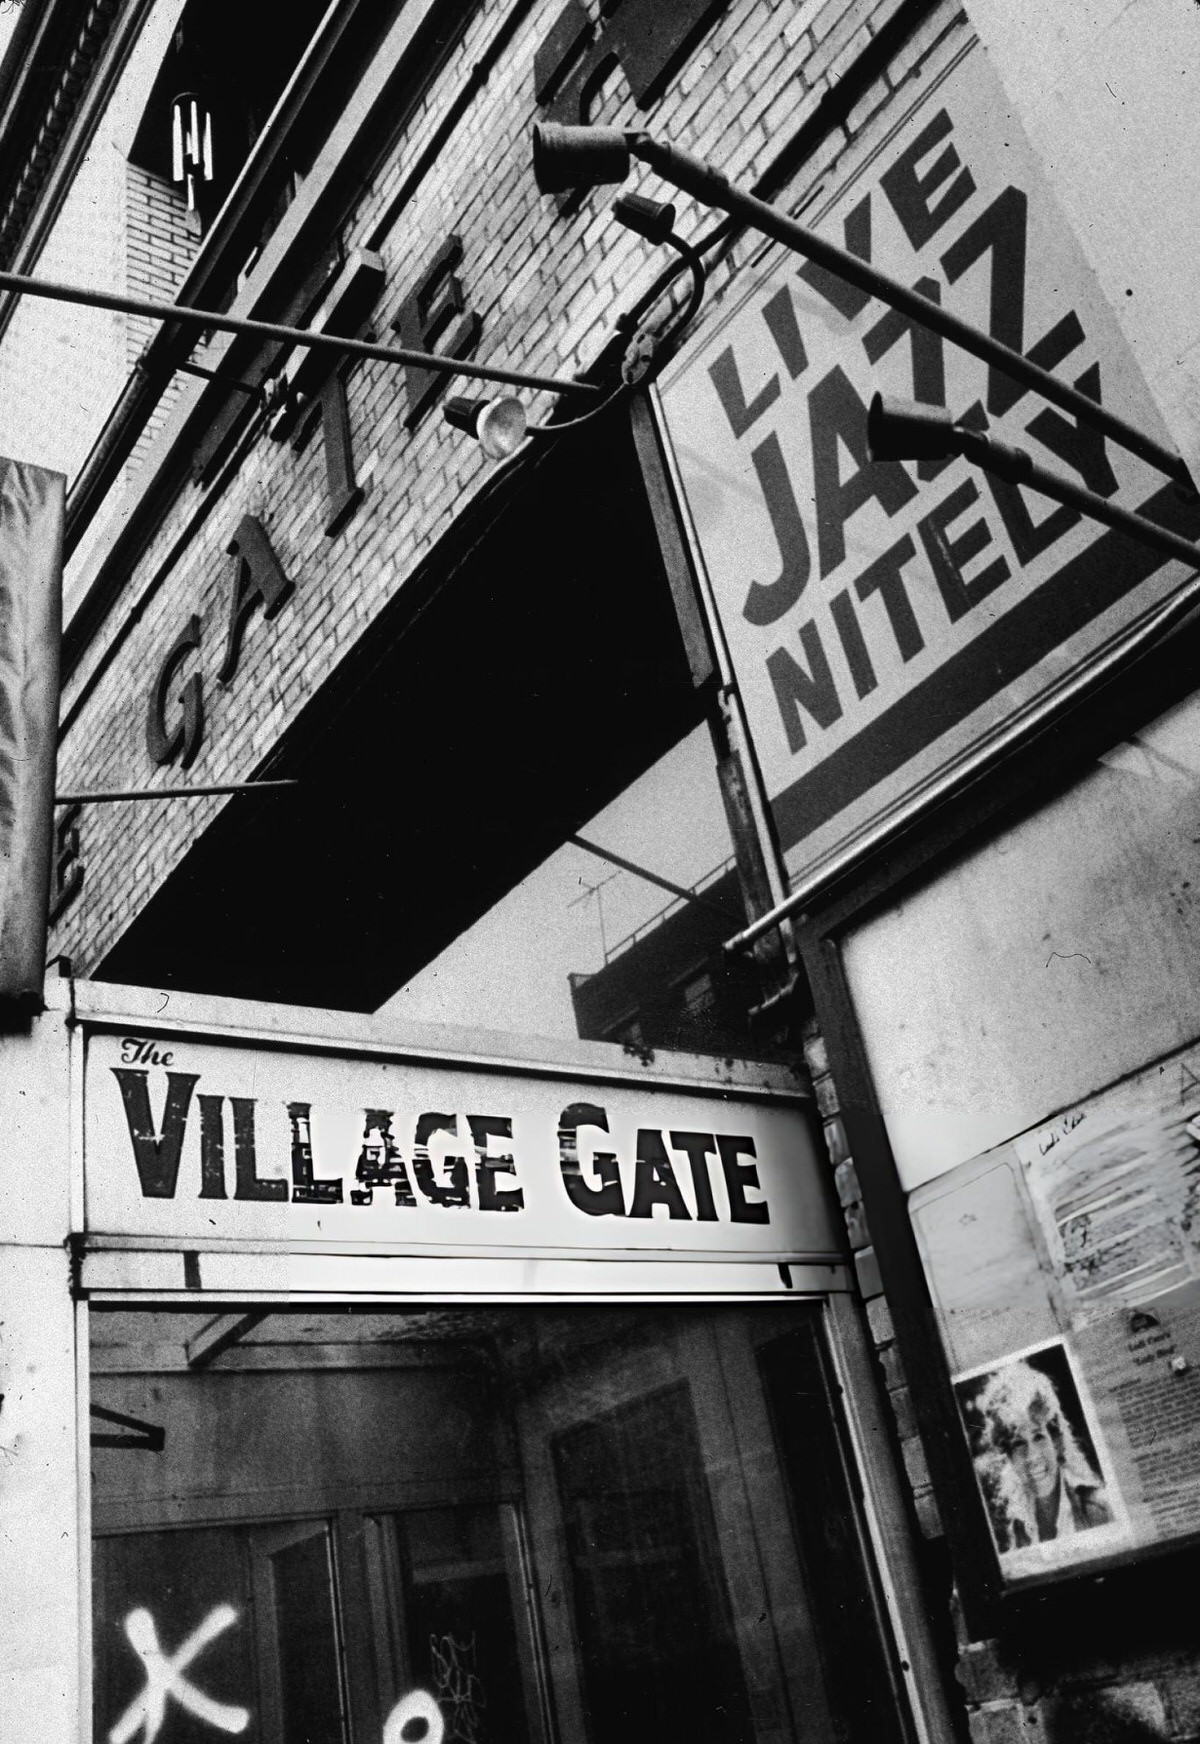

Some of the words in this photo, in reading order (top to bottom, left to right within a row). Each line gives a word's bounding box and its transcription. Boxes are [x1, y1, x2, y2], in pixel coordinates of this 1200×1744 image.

[707, 107, 978, 439] LIVE
[742, 185, 1087, 627] JAZZ
[145, 233, 483, 770] GATE
[765, 362, 1120, 755] NITELY
[109, 1067, 525, 1212] VILLAGE
[557, 1102, 771, 1225] GATE
[121, 1037, 175, 1067] The
